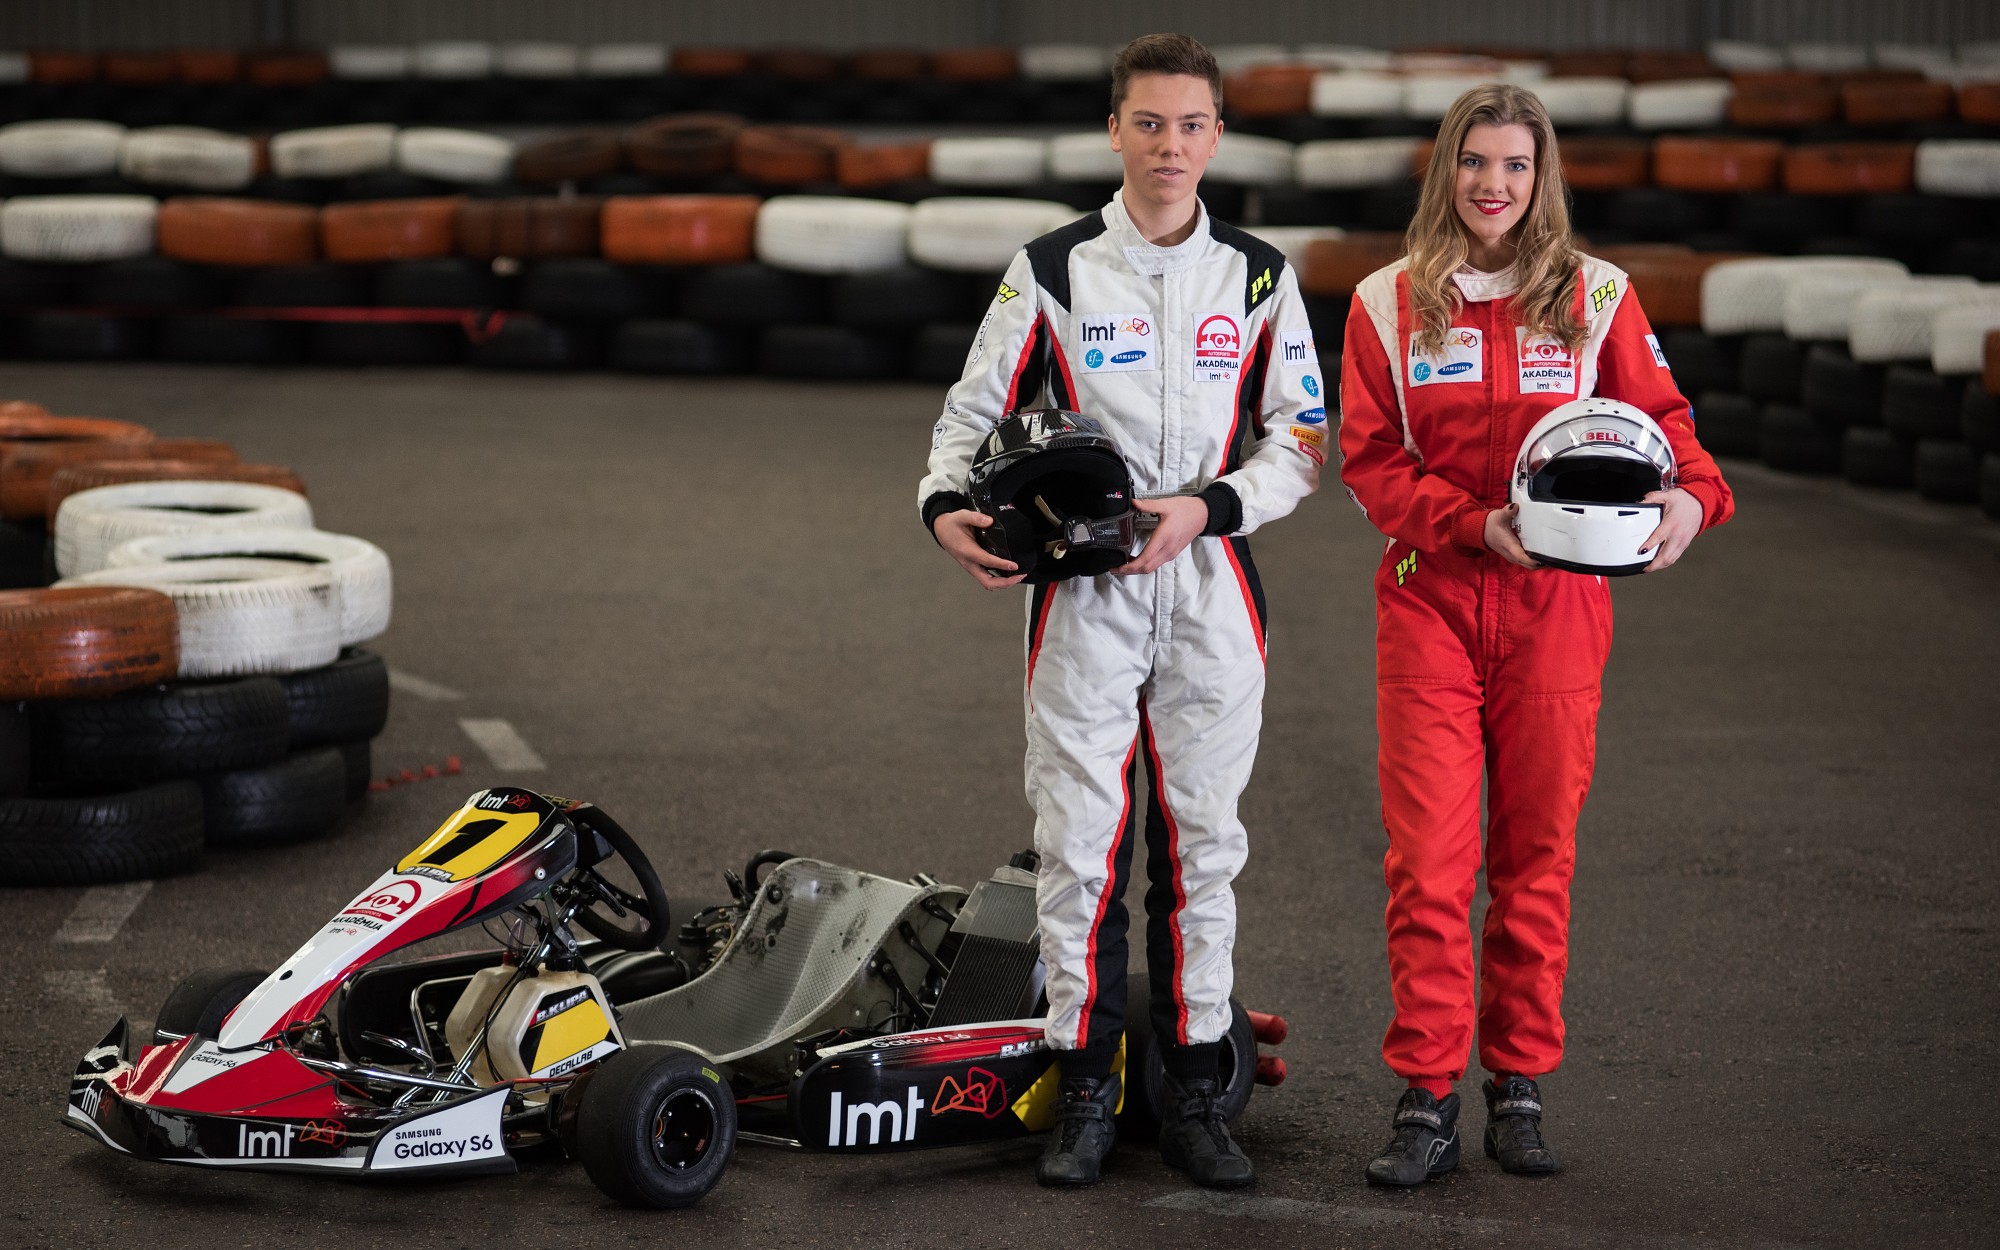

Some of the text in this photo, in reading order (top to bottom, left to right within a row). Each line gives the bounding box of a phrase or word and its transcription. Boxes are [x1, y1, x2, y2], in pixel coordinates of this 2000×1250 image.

[1591, 279, 1617, 313] P1
[1082, 322, 1116, 342] lmt
[1115, 353, 1143, 361] SAMSUNG
[1284, 340, 1306, 361] lmt
[1195, 359, 1239, 370] AKADĒMIJA
[1442, 364, 1470, 372] SAMSUNG
[1209, 372, 1221, 381] lmt
[1522, 369, 1573, 379] AKADĒMIJA
[1585, 432, 1621, 442] BELL
[1395, 549, 1418, 587] P1
[479, 794, 509, 809] lmt
[418, 818, 509, 866] 1
[331, 916, 384, 931] AKADĒMIJA
[536, 989, 588, 1024] B.KLIPA
[871, 1035, 945, 1048] Galaxy
[549, 1049, 593, 1078] DECALLAB
[828, 1085, 924, 1147] lmt
[238, 1123, 295, 1158] lmt
[395, 1128, 442, 1140] SAMSUNG
[394, 1134, 493, 1159] Galaxy S6
